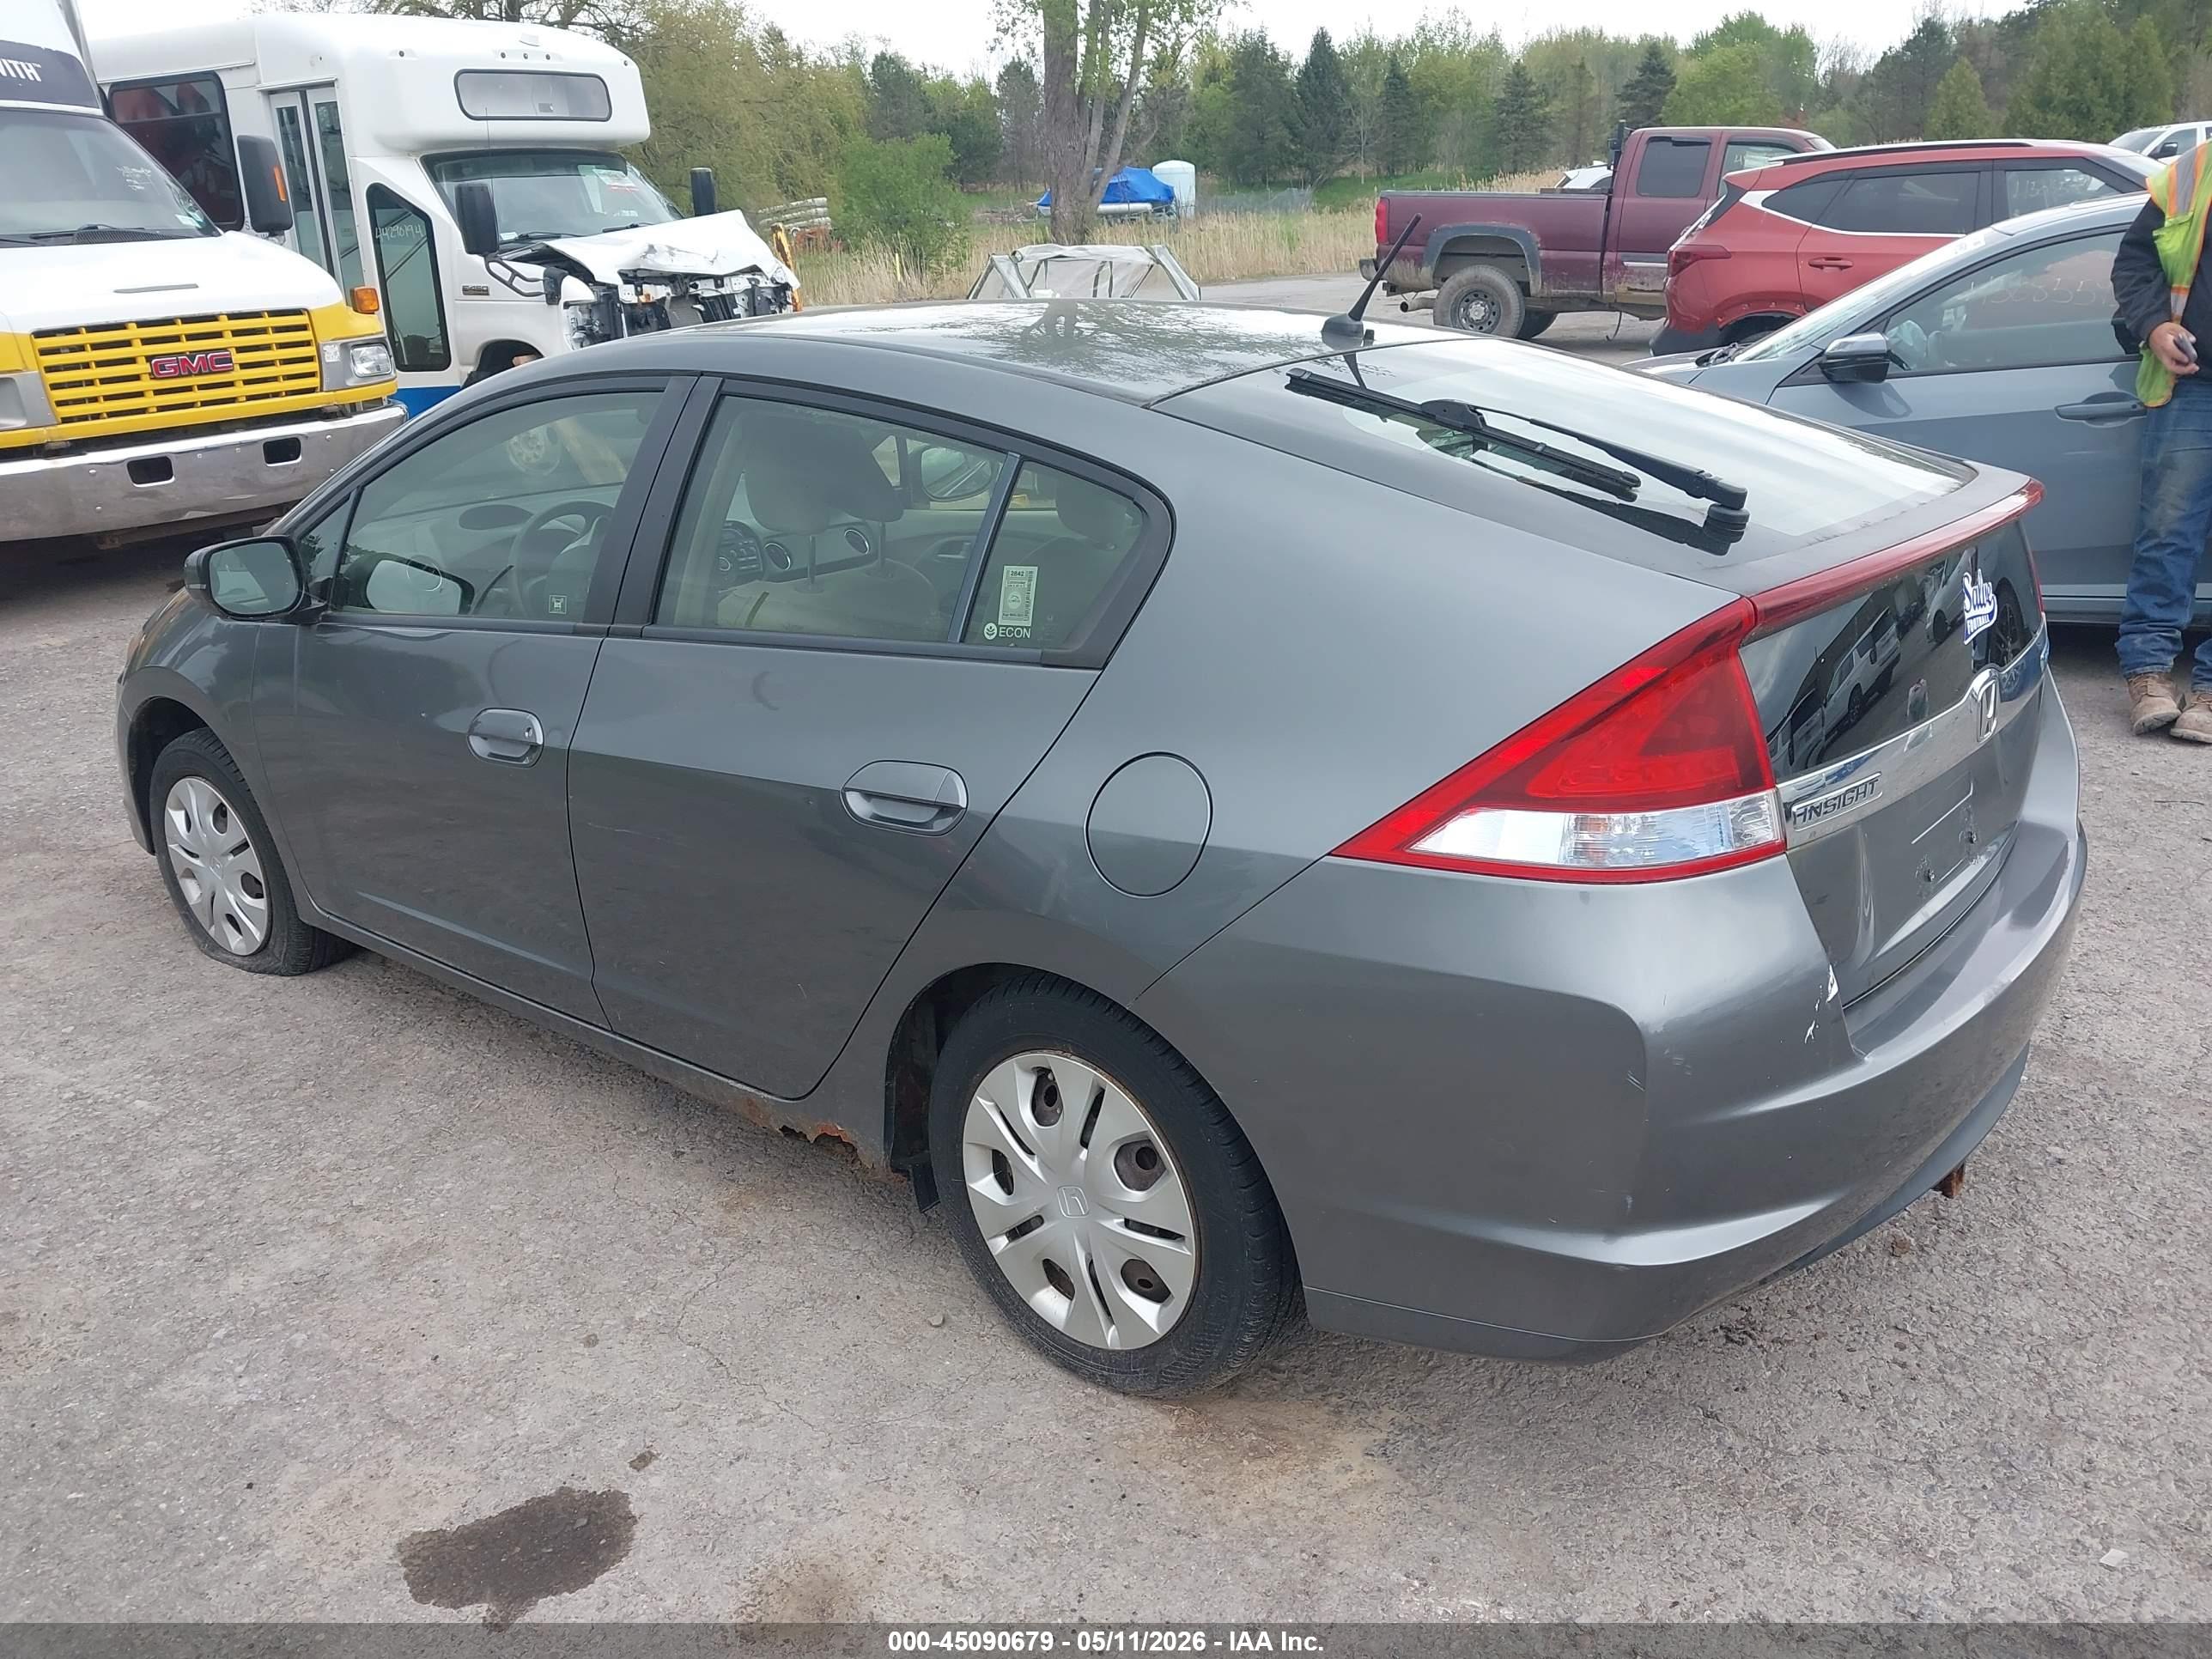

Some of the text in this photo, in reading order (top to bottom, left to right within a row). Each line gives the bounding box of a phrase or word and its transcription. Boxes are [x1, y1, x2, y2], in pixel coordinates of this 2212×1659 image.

[151, 351, 234, 378] GMC
[999, 627, 1031, 639] ECON
[1794, 778, 1880, 824] INSIGHT
